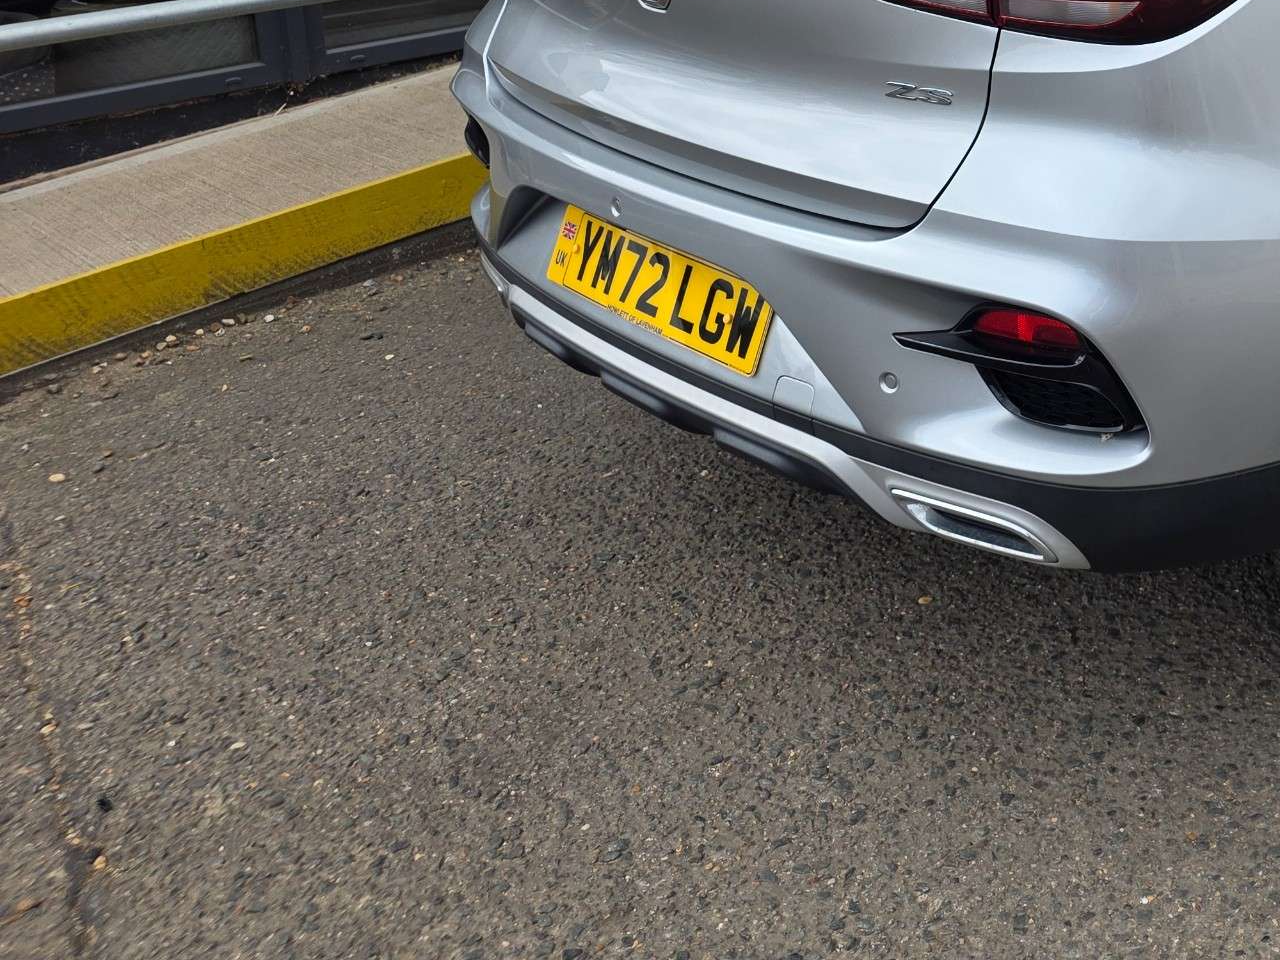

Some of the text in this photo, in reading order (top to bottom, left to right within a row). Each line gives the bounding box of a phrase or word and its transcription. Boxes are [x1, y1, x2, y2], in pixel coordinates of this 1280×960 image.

[555, 249, 568, 267] UK
[576, 220, 766, 360] YM72 LGW
